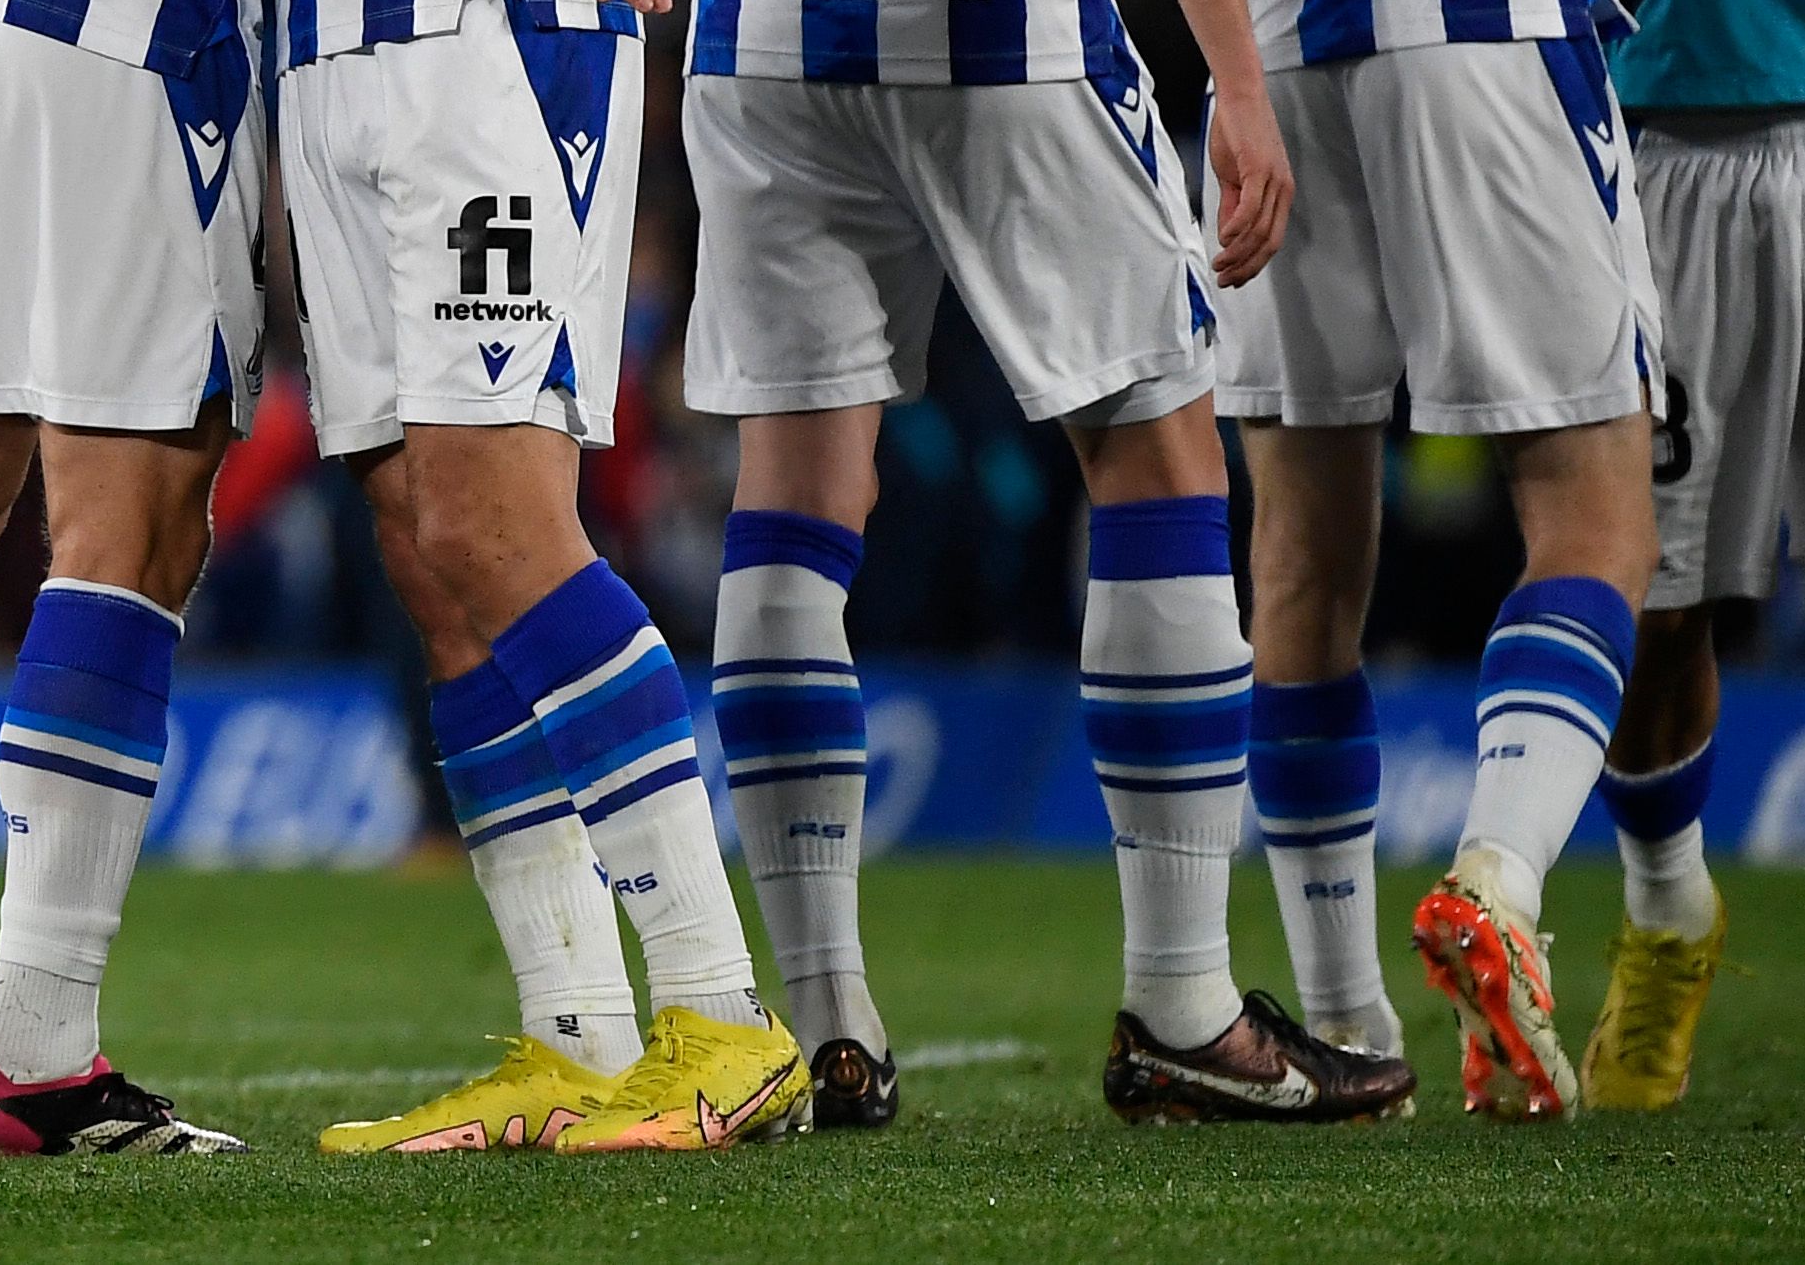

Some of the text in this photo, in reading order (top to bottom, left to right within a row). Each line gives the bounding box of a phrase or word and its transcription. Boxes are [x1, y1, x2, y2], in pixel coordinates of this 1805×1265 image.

[447, 195, 533, 296] fi
[434, 299, 555, 322] network
[614, 871, 659, 896] RS
